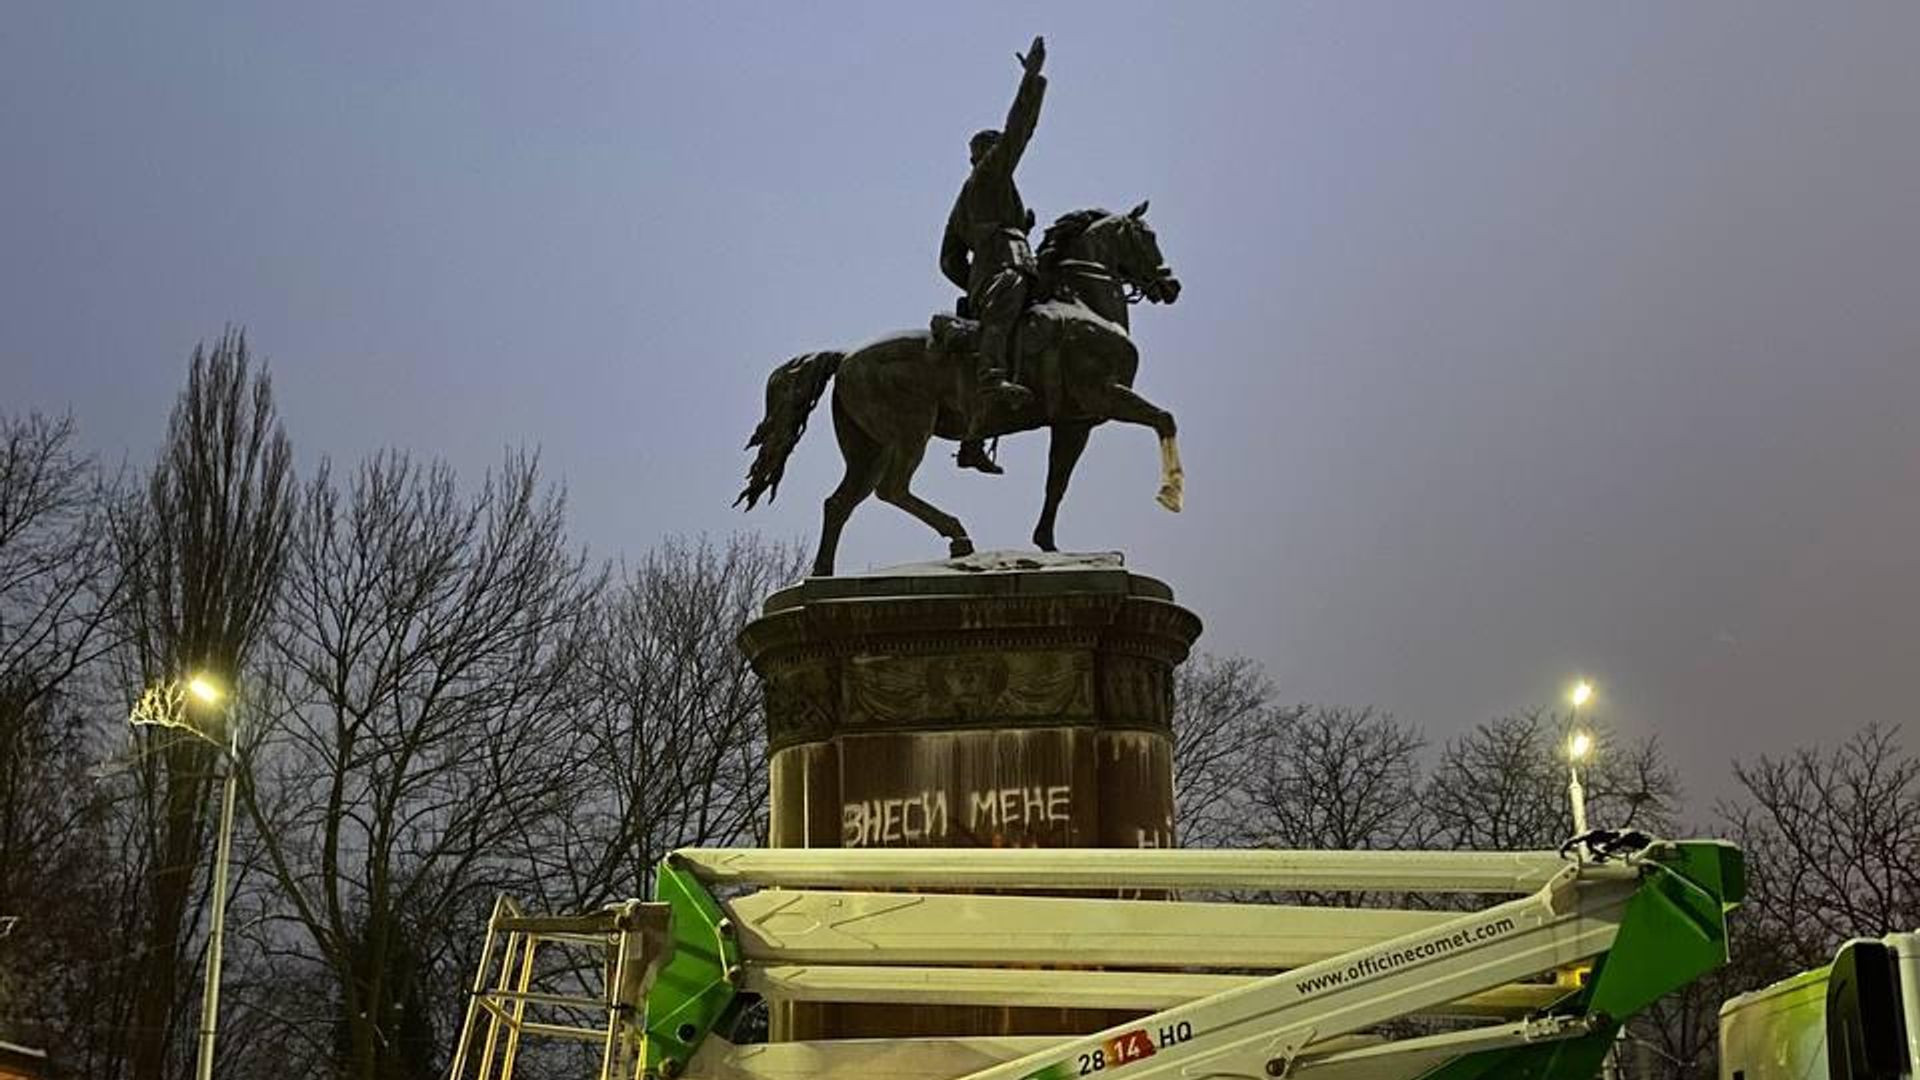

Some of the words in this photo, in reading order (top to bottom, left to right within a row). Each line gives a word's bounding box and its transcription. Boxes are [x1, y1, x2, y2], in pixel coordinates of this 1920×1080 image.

[844, 790, 948, 848] ЗНЕСИ
[970, 786, 1071, 831] МЕНЕ
[1296, 917, 1515, 994] www.officinecomet.com
[1078, 1049, 1105, 1076] 28
[1114, 1036, 1140, 1062] 14
[1159, 1021, 1193, 1048] HQ
